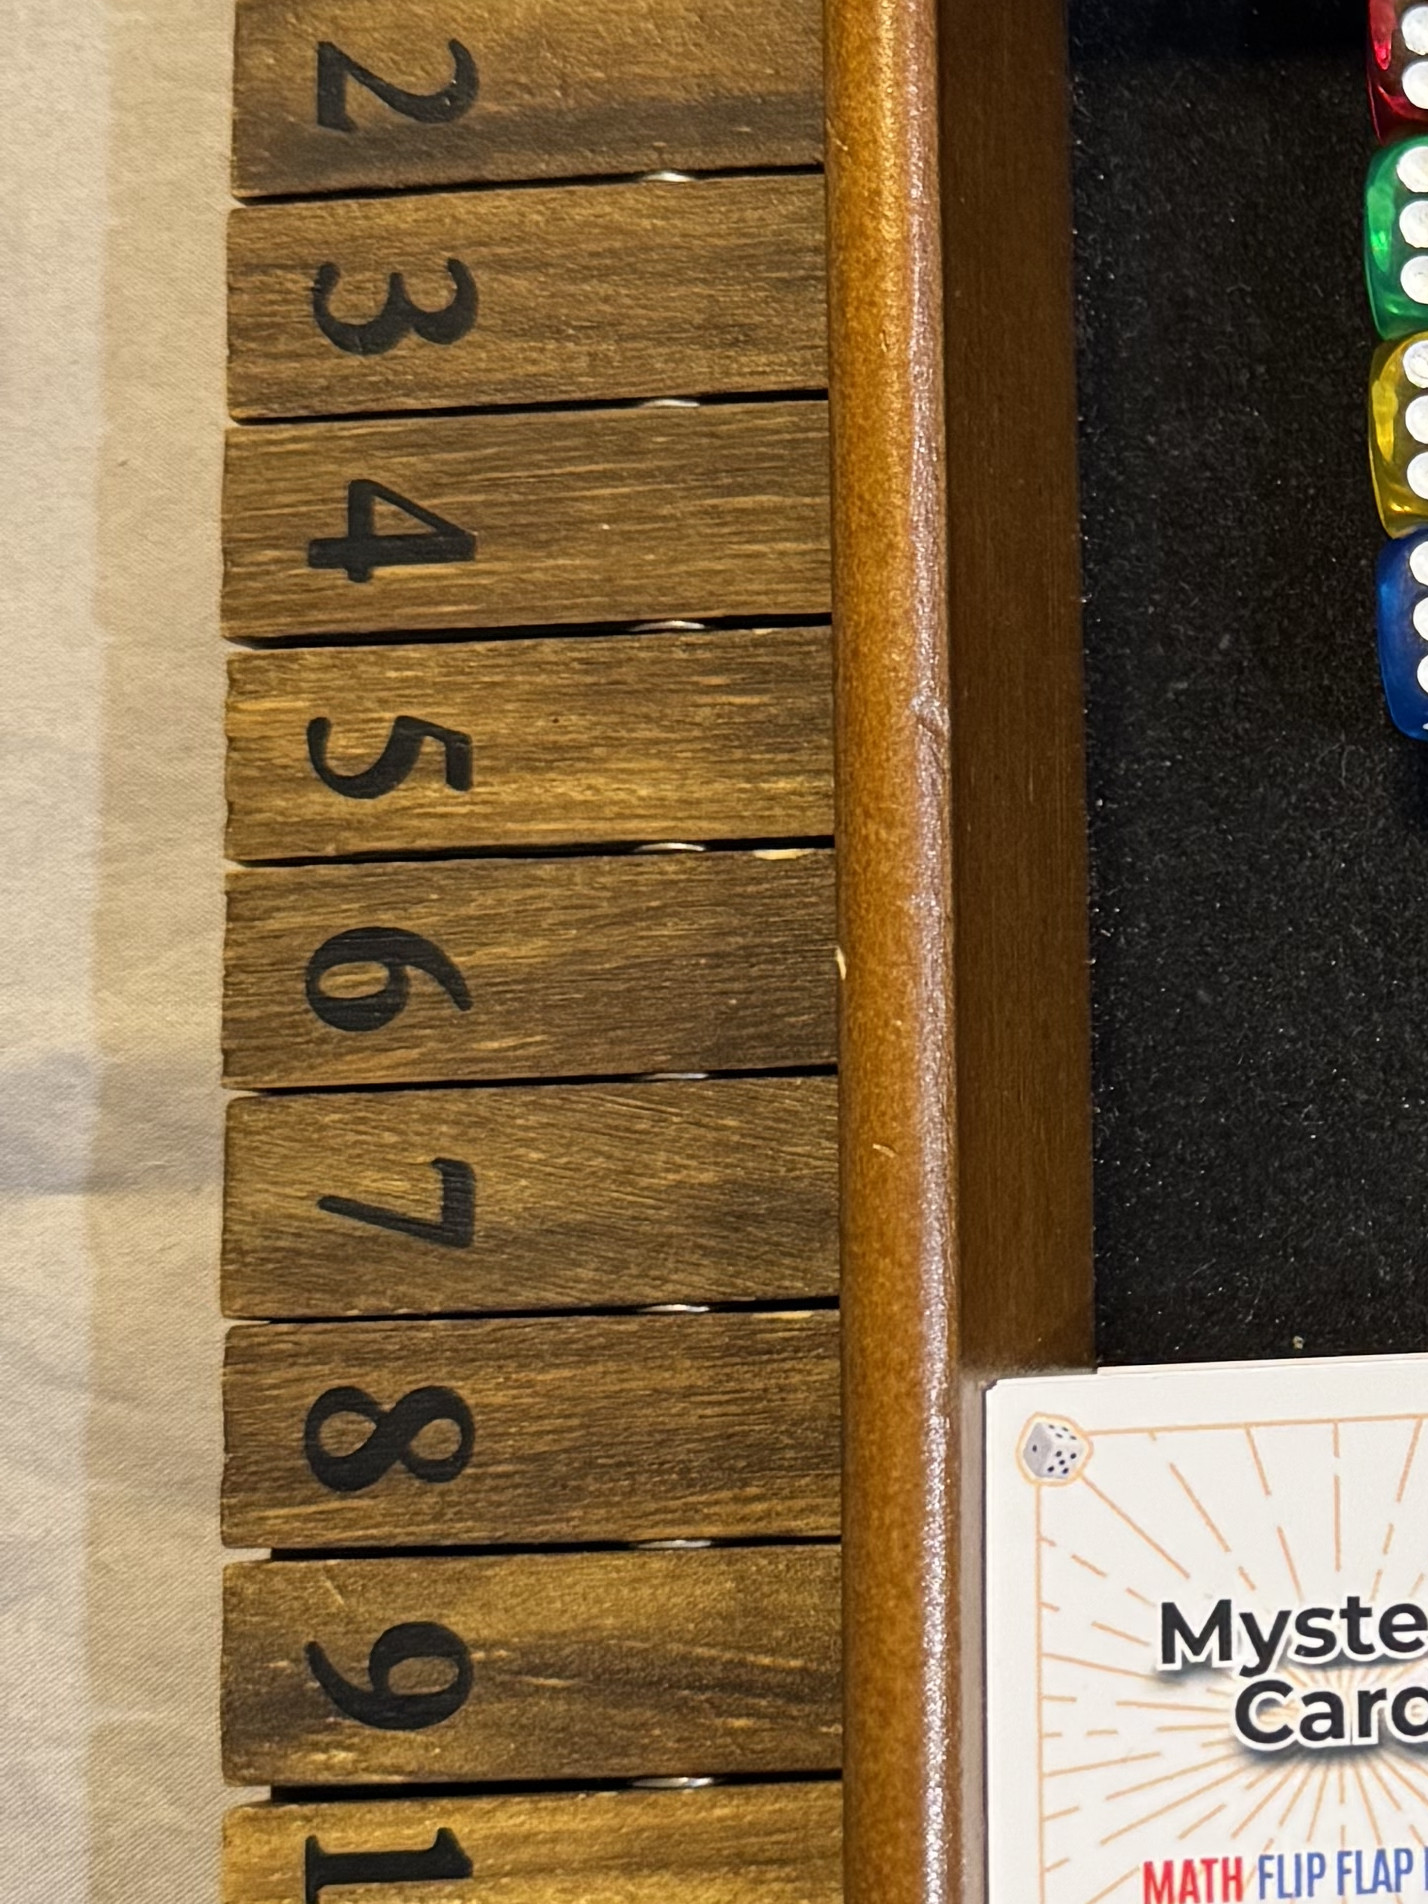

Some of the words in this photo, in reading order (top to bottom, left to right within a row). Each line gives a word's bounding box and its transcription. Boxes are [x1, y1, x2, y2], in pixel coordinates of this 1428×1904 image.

[316, 39, 479, 131] 2
[312, 259, 478, 355] 3
[307, 479, 476, 582] 4
[306, 714, 473, 798] 5
[306, 927, 472, 1031] 6
[317, 1156, 475, 1247] 7
[305, 1386, 475, 1492] 8
[306, 1620, 474, 1730] 9
[1258, 1852, 1326, 1900] FLIP
[1337, 1848, 1414, 1895] FLAP
